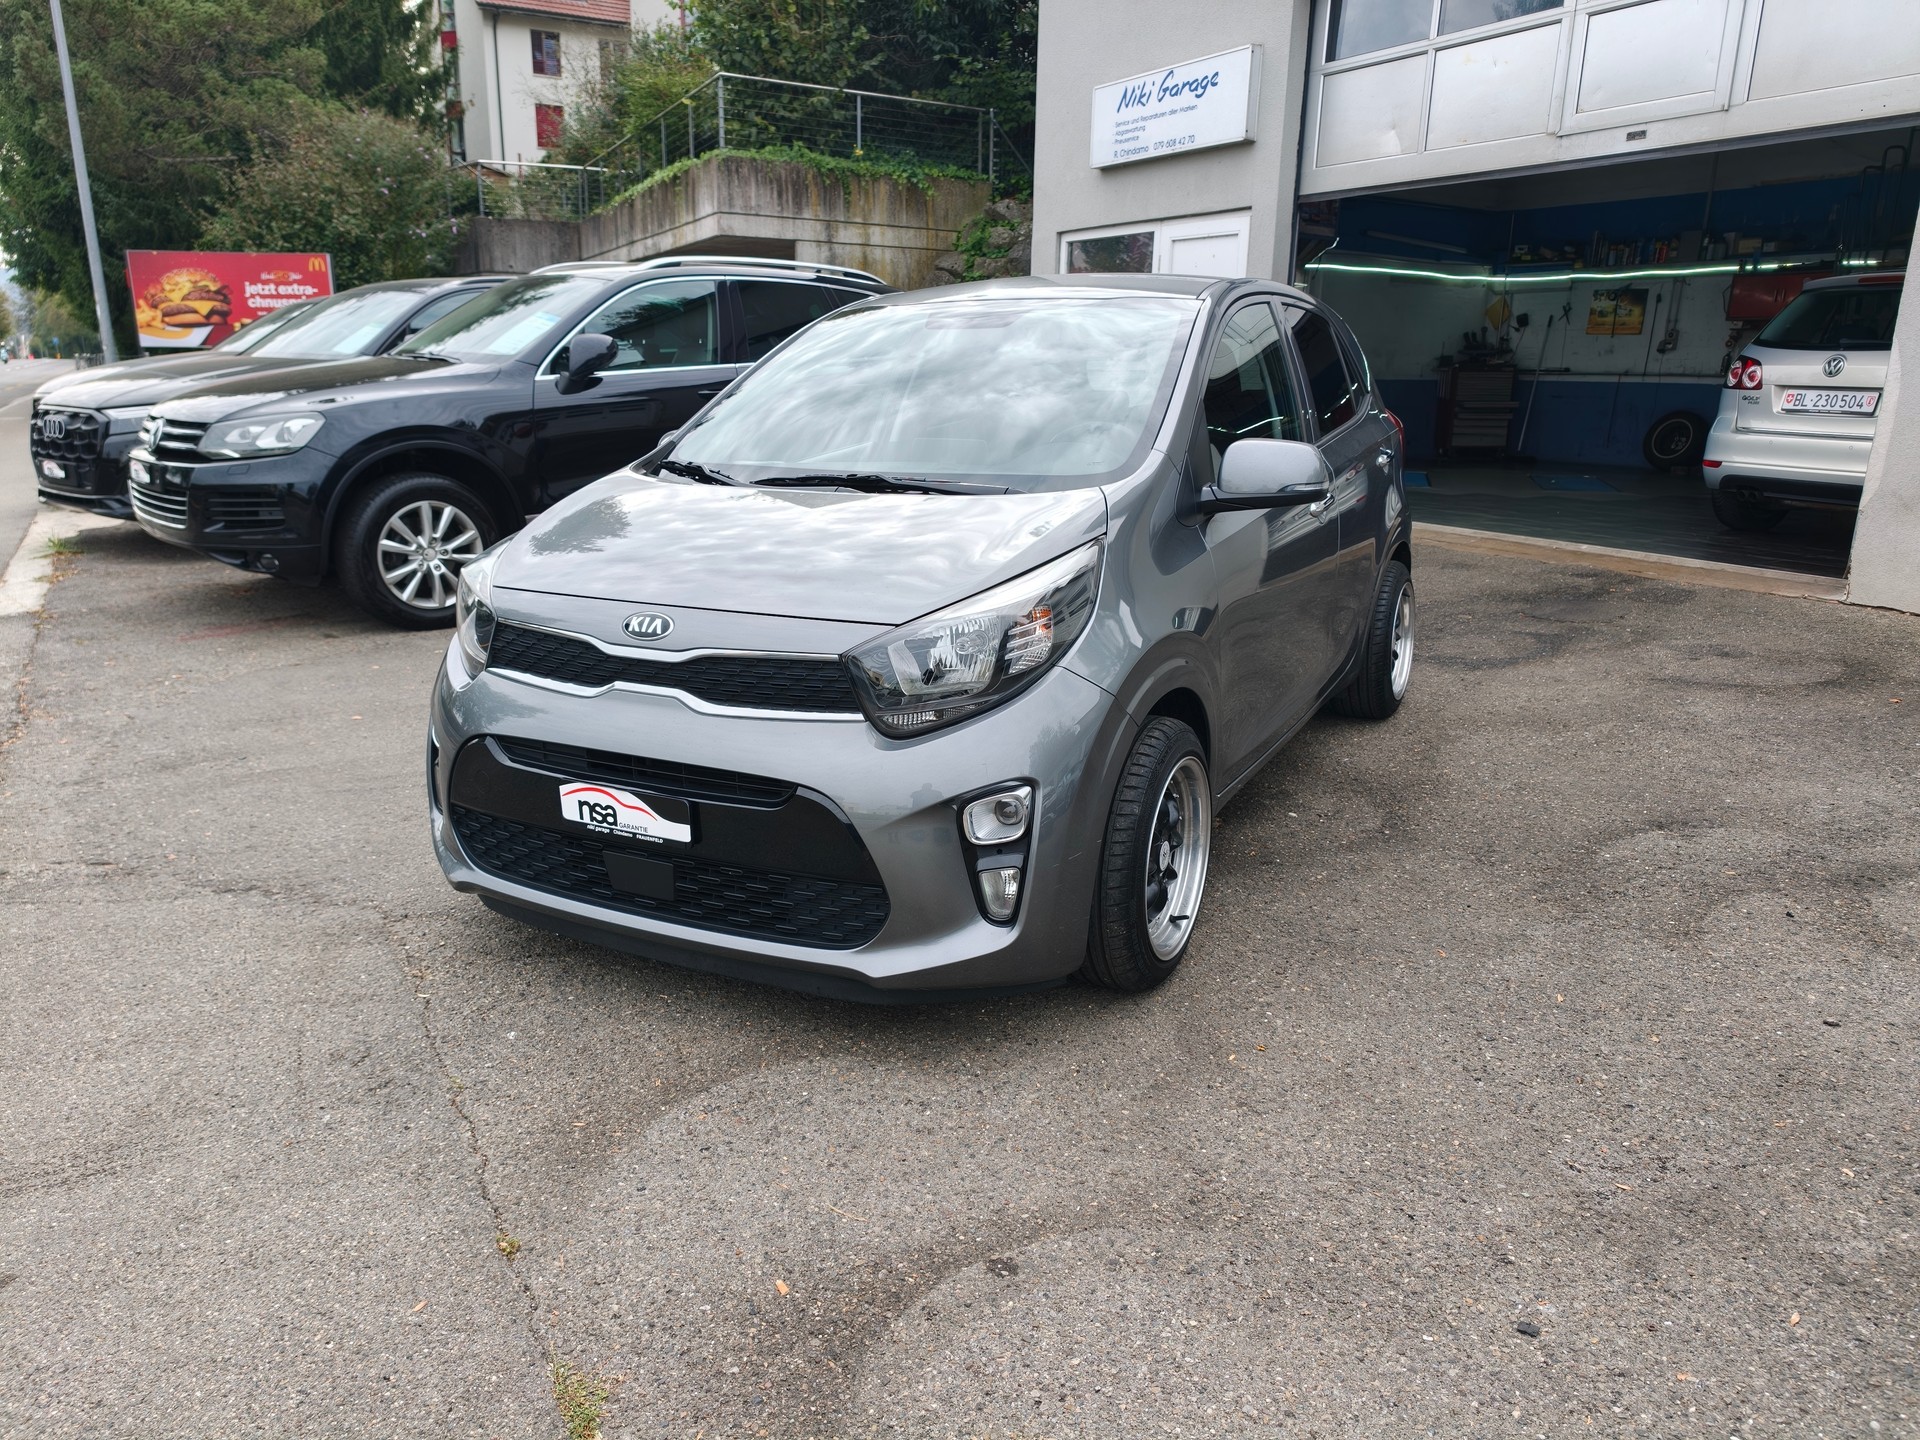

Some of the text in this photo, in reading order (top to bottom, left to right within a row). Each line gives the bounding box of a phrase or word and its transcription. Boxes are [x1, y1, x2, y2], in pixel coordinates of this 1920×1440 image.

[1117, 70, 1219, 113] Niki Garage
[1140, 111, 1167, 122] Reparaturen
[1168, 108, 1178, 116] aller
[1179, 104, 1198, 113] Marken
[1120, 146, 1149, 157] Chindamo
[1153, 141, 1165, 151] 079
[1166, 138, 1176, 148] 608
[1178, 136, 1186, 146] 42
[1187, 134, 1195, 144] 70
[244, 281, 318, 297] jetzt extra-
[628, 616, 662, 634] KIA
[577, 799, 618, 827] nsa
[618, 822, 648, 833] GARANTIE
